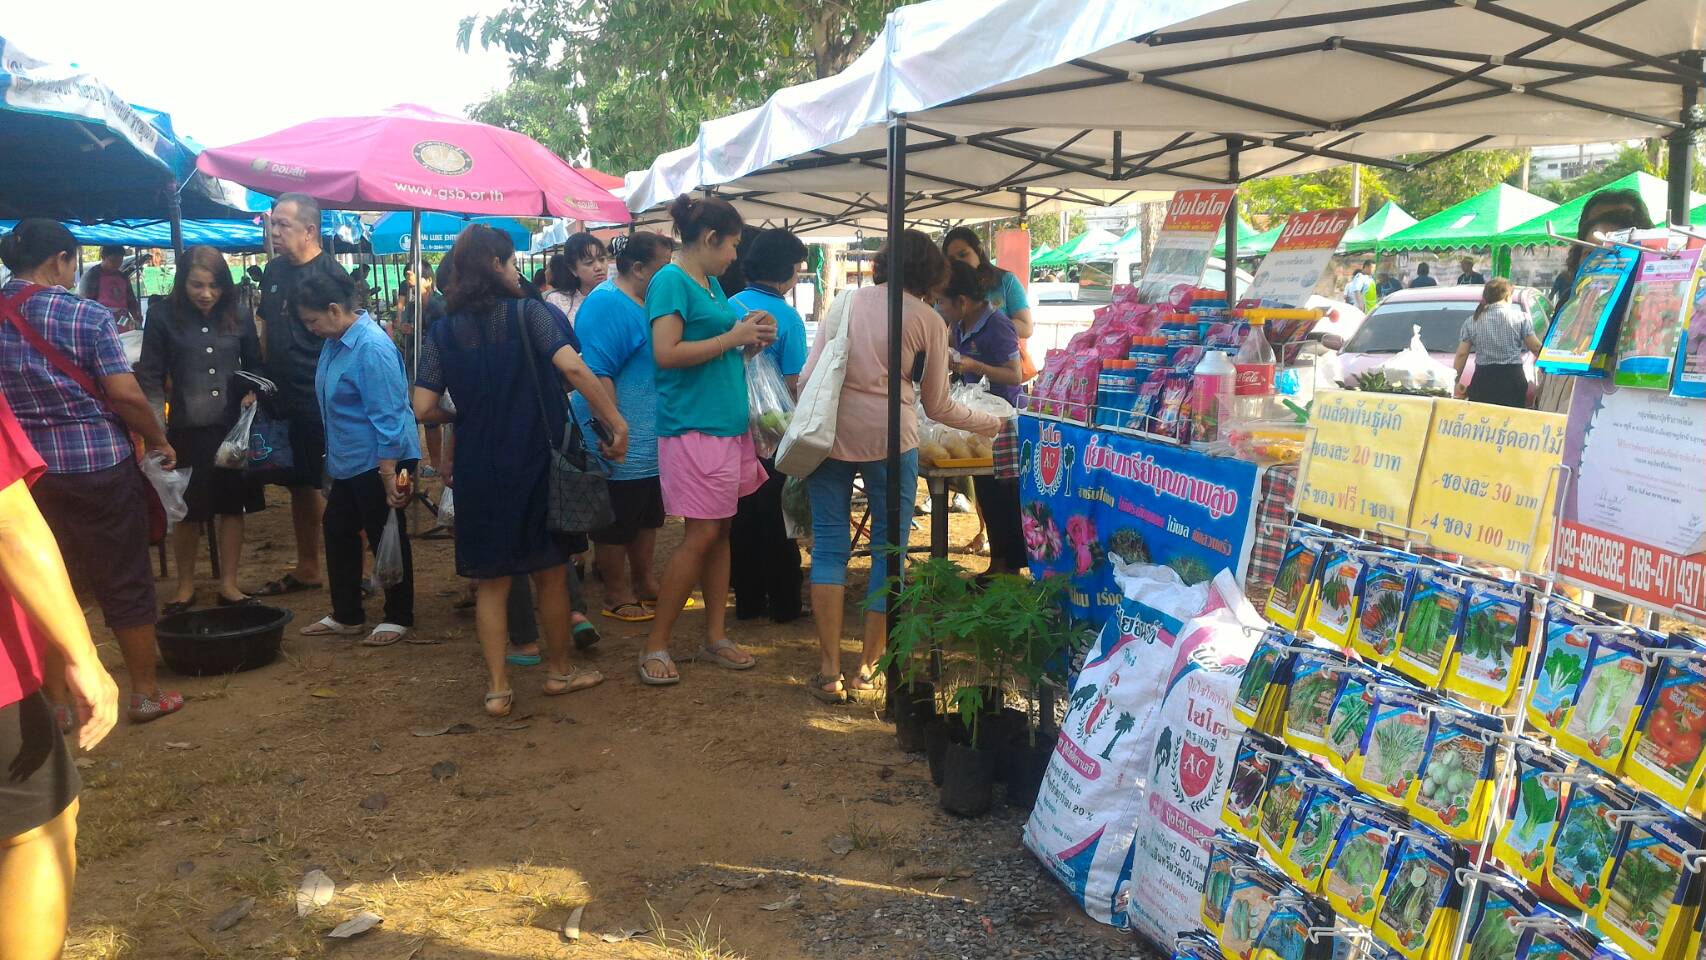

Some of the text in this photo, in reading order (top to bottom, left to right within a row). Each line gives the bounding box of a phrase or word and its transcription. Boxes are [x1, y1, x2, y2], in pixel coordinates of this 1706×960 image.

[394, 182, 504, 201] www.gsb.or.th
[1043, 451, 1056, 470] AC
[1312, 441, 1401, 472] ซองละ 20 บาท
[1084, 434, 1238, 520] ปุ๋ยอินทรีย์คุณภาพสูง
[1442, 472, 1538, 510] ซองละ 30 บาท
[1302, 483, 1395, 521] 5 ซอง ฟรี 1 ซอง
[1430, 512, 1530, 556] 4 ซอง 100 บาท
[1184, 753, 1208, 779] AC
[1072, 804, 1085, 816] 20
[1179, 845, 1191, 862] 50
